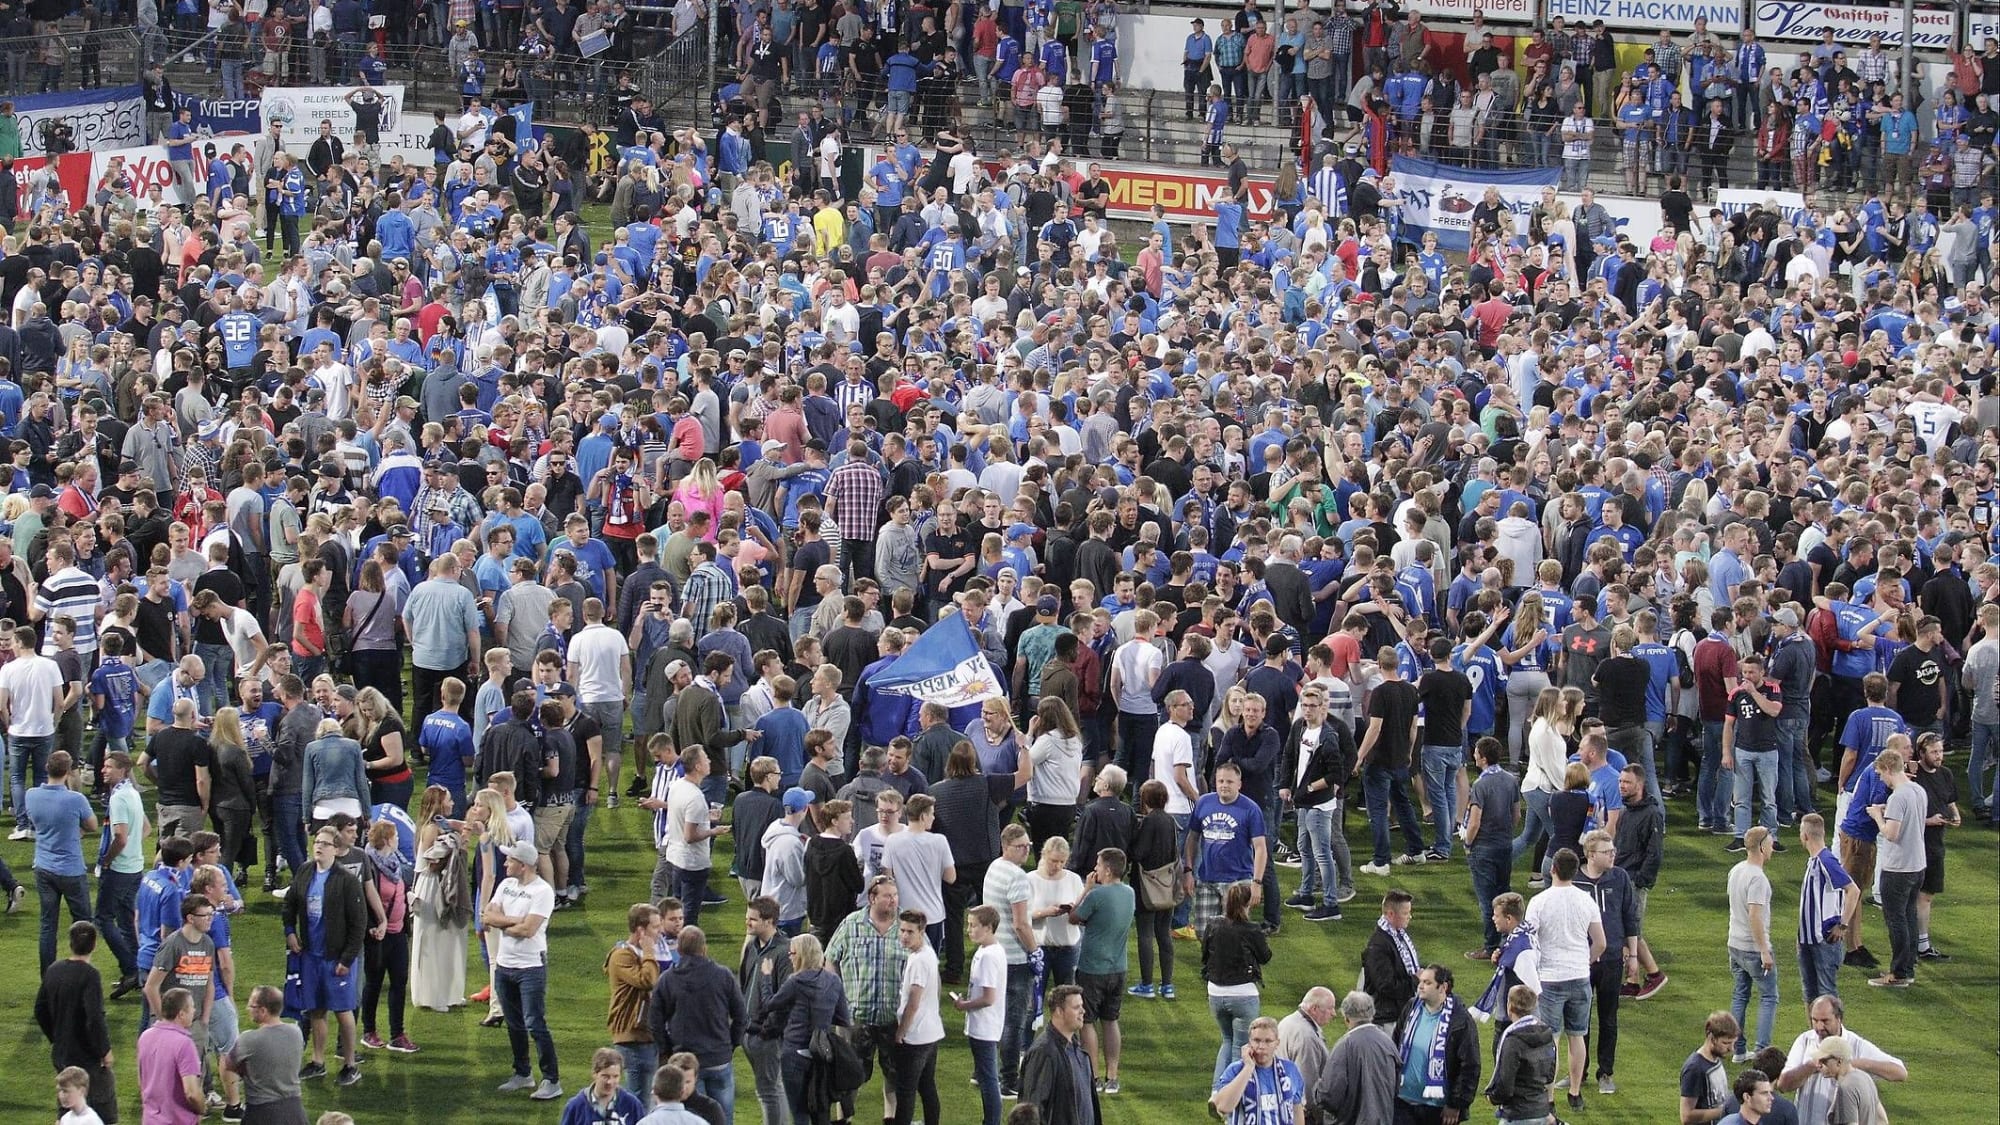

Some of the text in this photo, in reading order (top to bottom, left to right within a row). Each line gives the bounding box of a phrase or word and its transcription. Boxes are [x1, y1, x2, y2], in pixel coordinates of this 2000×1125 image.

[1549, 0, 1739, 24] HEINZ HACKMANN
[311, 110, 350, 119] REBELS
[768, 219, 789, 239] 18
[934, 250, 953, 271] 20
[225, 321, 251, 341] 32
[1923, 411, 1935, 435] 5
